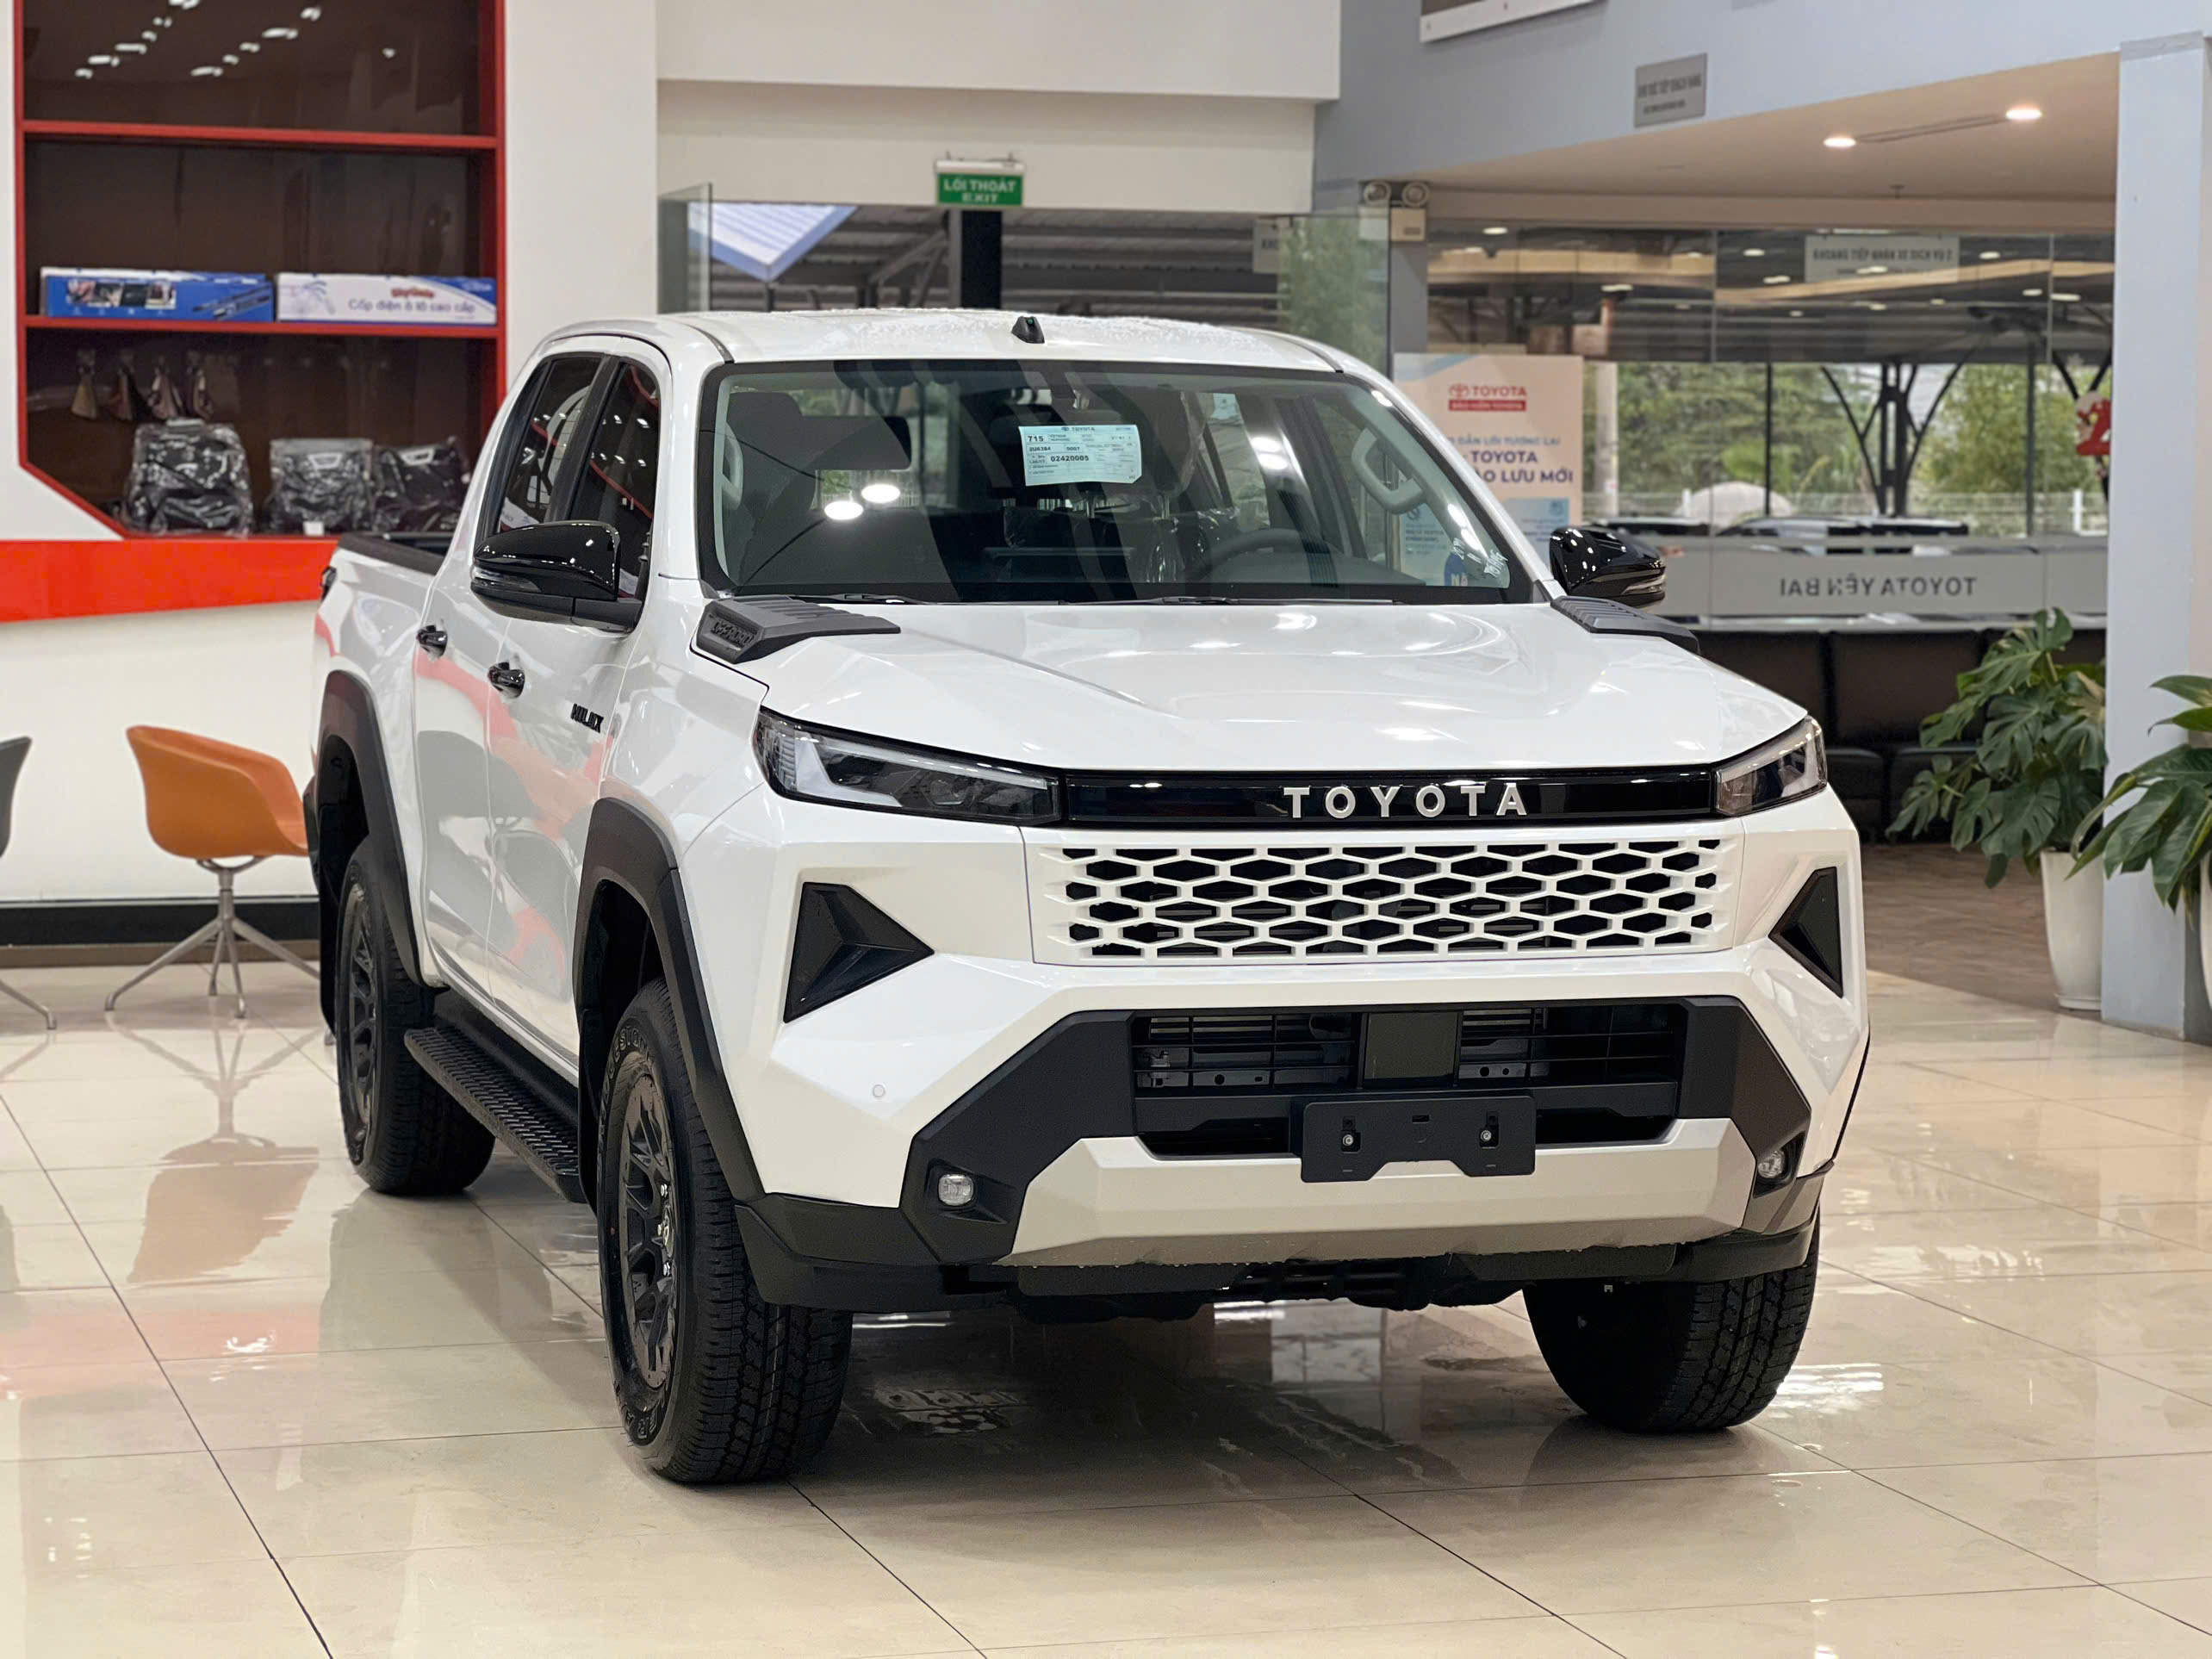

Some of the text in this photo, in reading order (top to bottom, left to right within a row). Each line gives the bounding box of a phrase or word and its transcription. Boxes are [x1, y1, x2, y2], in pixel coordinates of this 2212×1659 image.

[961, 192, 997, 203] EXIT
[1473, 385, 1526, 397] TOYOTA
[1471, 450, 1538, 464] TOYOTA
[1501, 468, 1536, 483] LƯU
[1540, 465, 1575, 483] MỚI
[1283, 782, 1527, 818] TOYOTA
